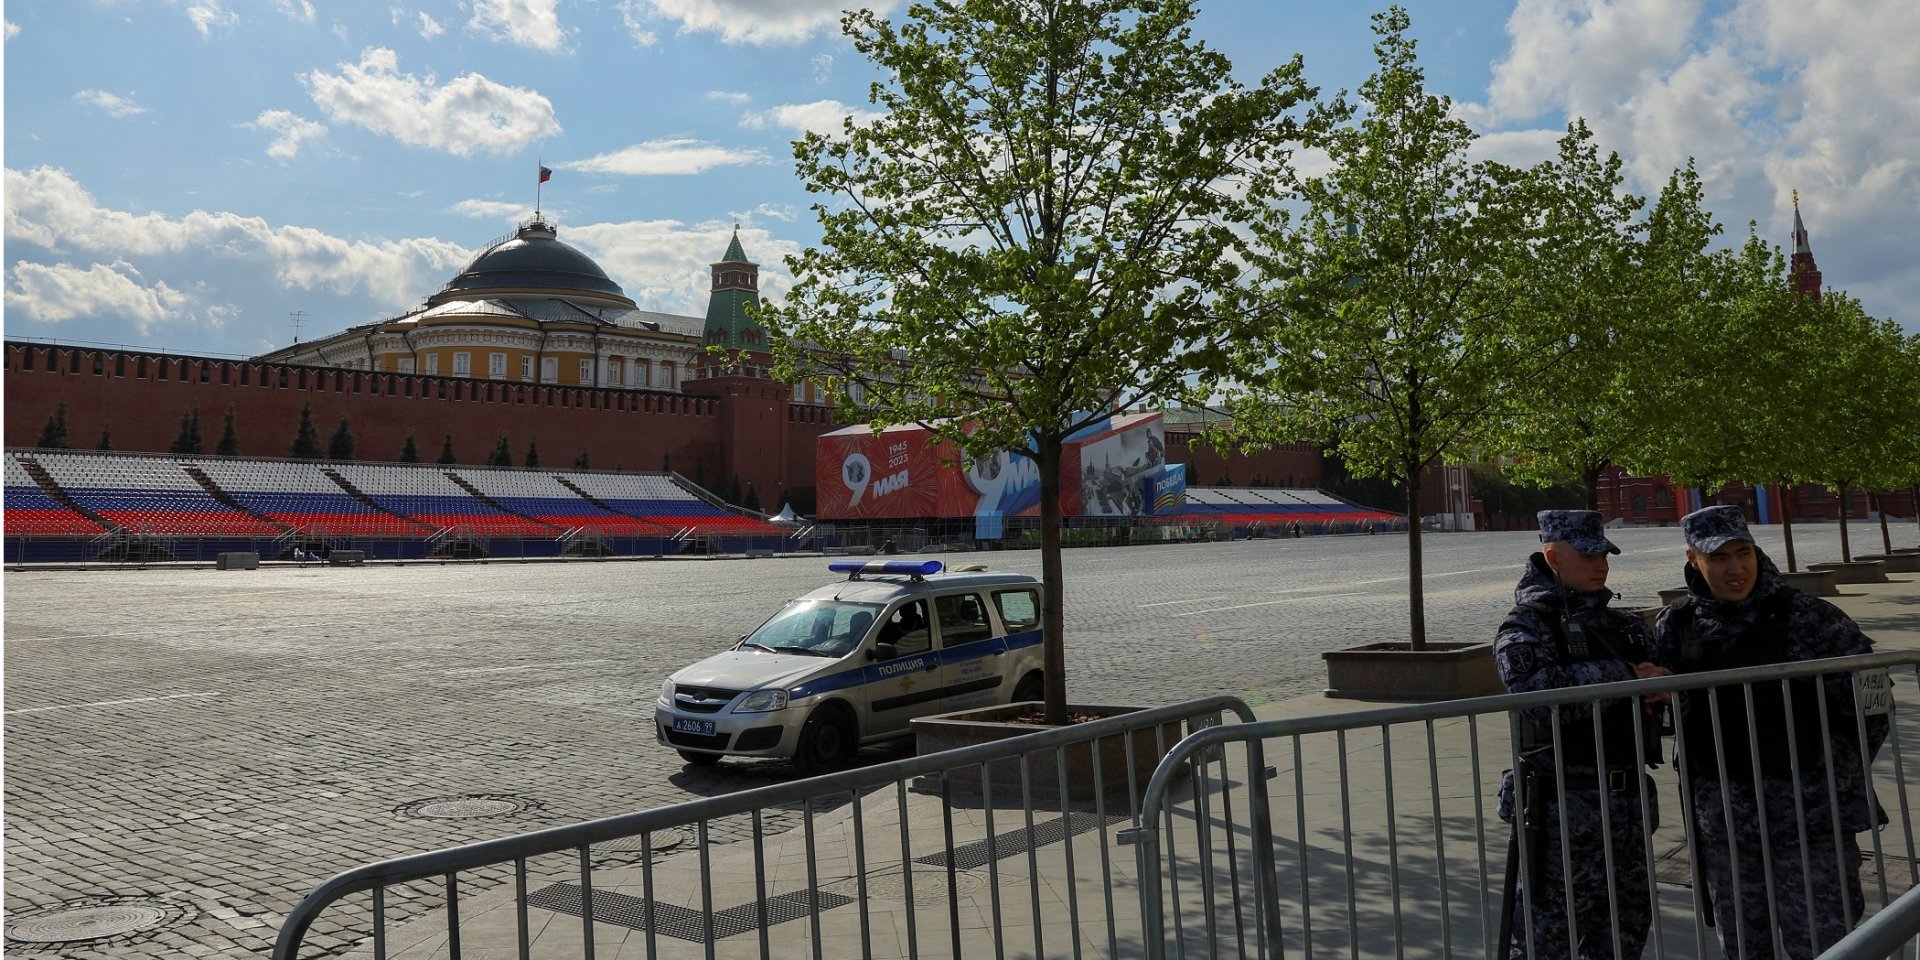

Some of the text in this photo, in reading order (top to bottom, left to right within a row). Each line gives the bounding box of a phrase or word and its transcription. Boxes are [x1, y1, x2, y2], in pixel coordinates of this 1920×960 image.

[889, 440, 908, 455] 1945
[888, 453, 909, 469] 2023
[842, 453, 909, 508] 9 МАЯ
[1005, 456, 1041, 496] МА
[878, 657, 925, 677] ПОЛИЦИЯ
[682, 719, 701, 732] 2606
[704, 721, 713, 730] 99
